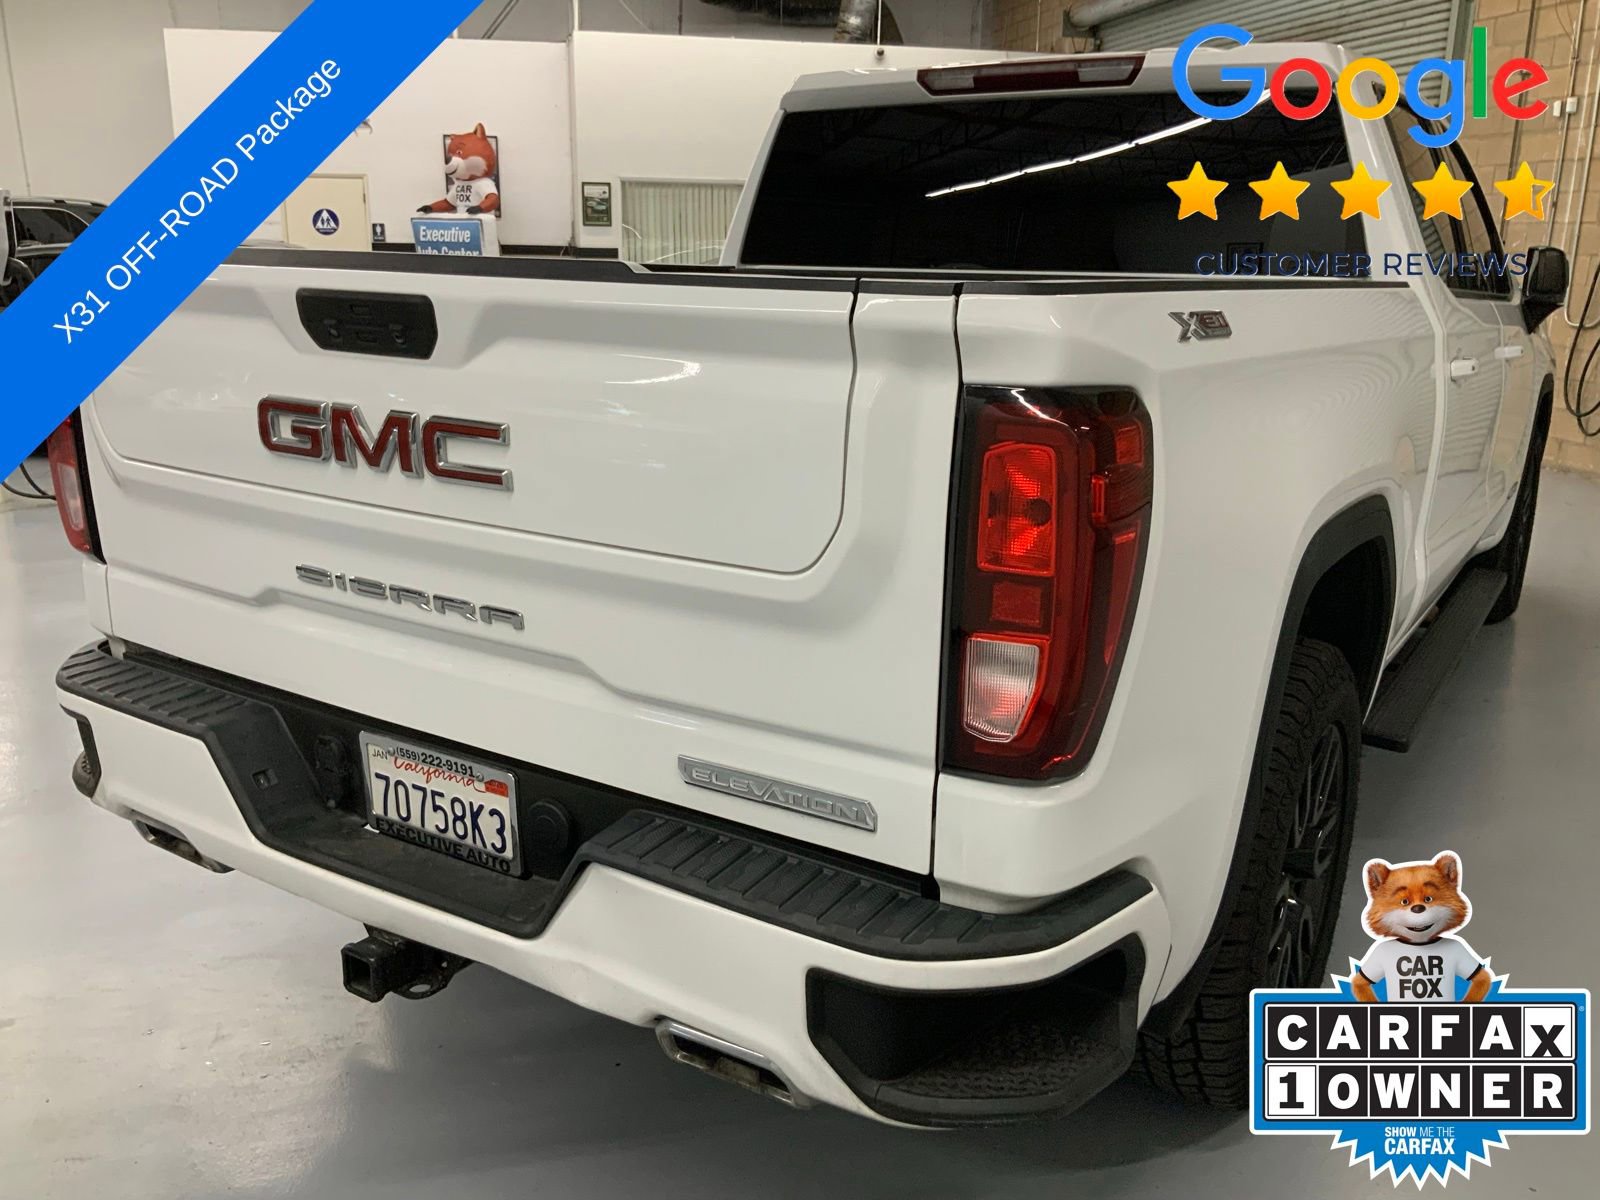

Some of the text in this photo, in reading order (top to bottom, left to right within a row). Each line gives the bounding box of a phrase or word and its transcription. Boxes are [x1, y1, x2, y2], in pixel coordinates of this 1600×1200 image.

[455, 185, 473, 194] CAR
[455, 194, 472, 203] FOX
[419, 225, 471, 243] Executive
[257, 394, 514, 493] GMC
[295, 563, 526, 631] SIERRA
[371, 748, 389, 761] JAN
[393, 757, 487, 794] California
[374, 771, 508, 855] 70758K3
[691, 766, 858, 822] ELEVATION
[375, 817, 511, 874] EXECUTIVE AUTO
